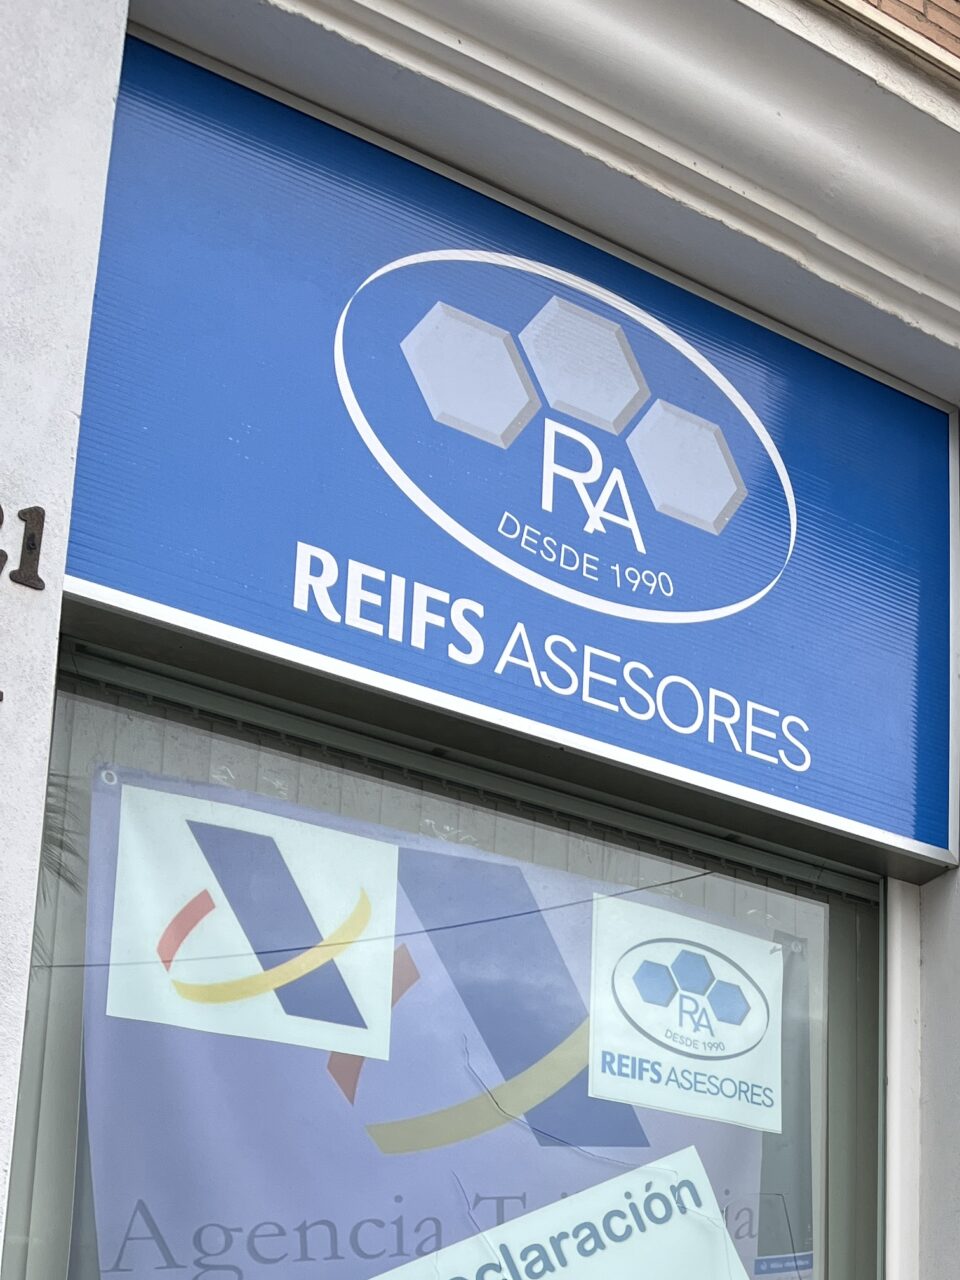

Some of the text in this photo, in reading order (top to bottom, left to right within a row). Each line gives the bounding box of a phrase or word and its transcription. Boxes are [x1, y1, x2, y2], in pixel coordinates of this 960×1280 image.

[541, 417, 646, 554] RA
[0, 504, 46, 590] 1
[497, 511, 674, 597] DESDE 1990
[293, 541, 811, 772] REIFS ASESORES
[664, 1028, 725, 1051] DESDE 1990
[678, 994, 715, 1037] RA
[601, 1050, 775, 1108] REIFS ASESORES
